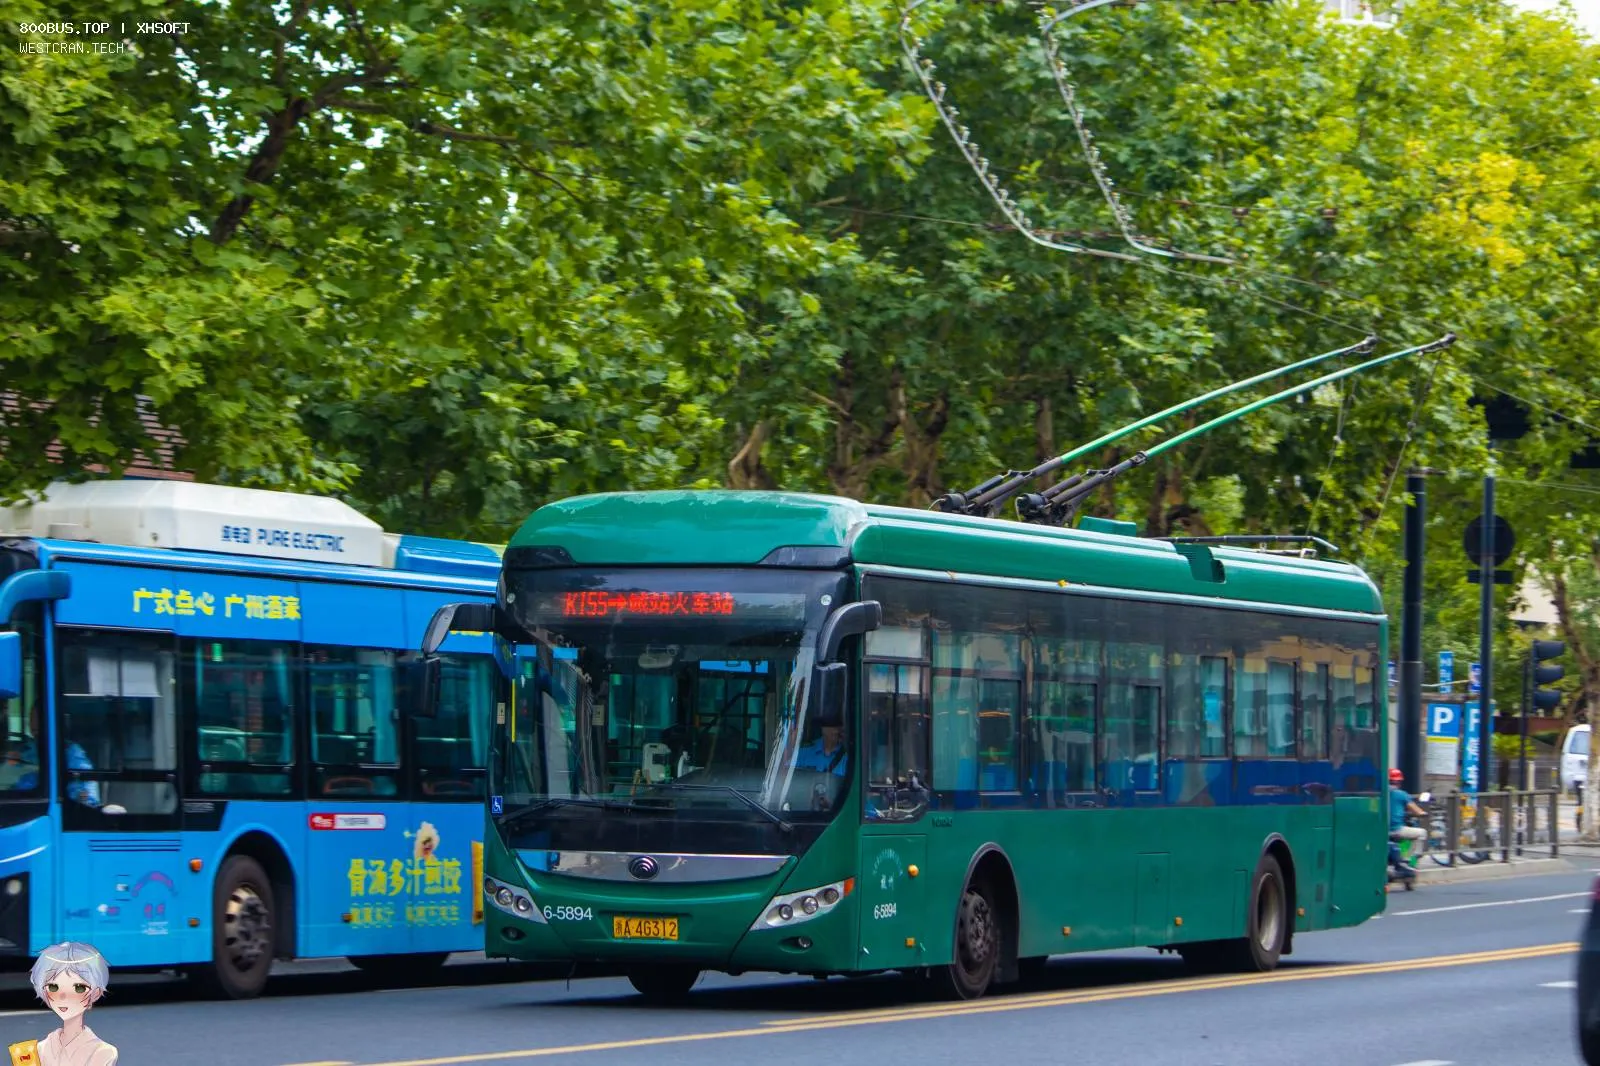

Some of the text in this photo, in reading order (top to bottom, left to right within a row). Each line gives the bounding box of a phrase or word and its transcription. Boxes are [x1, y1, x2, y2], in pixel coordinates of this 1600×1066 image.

[256, 528, 345, 552] PURE ELECTRIC
[132, 587, 302, 619] 广式点心 广州酒家
[1432, 706, 1455, 733] P
[543, 905, 593, 921] 6-5894
[873, 902, 897, 920] 6-5894
